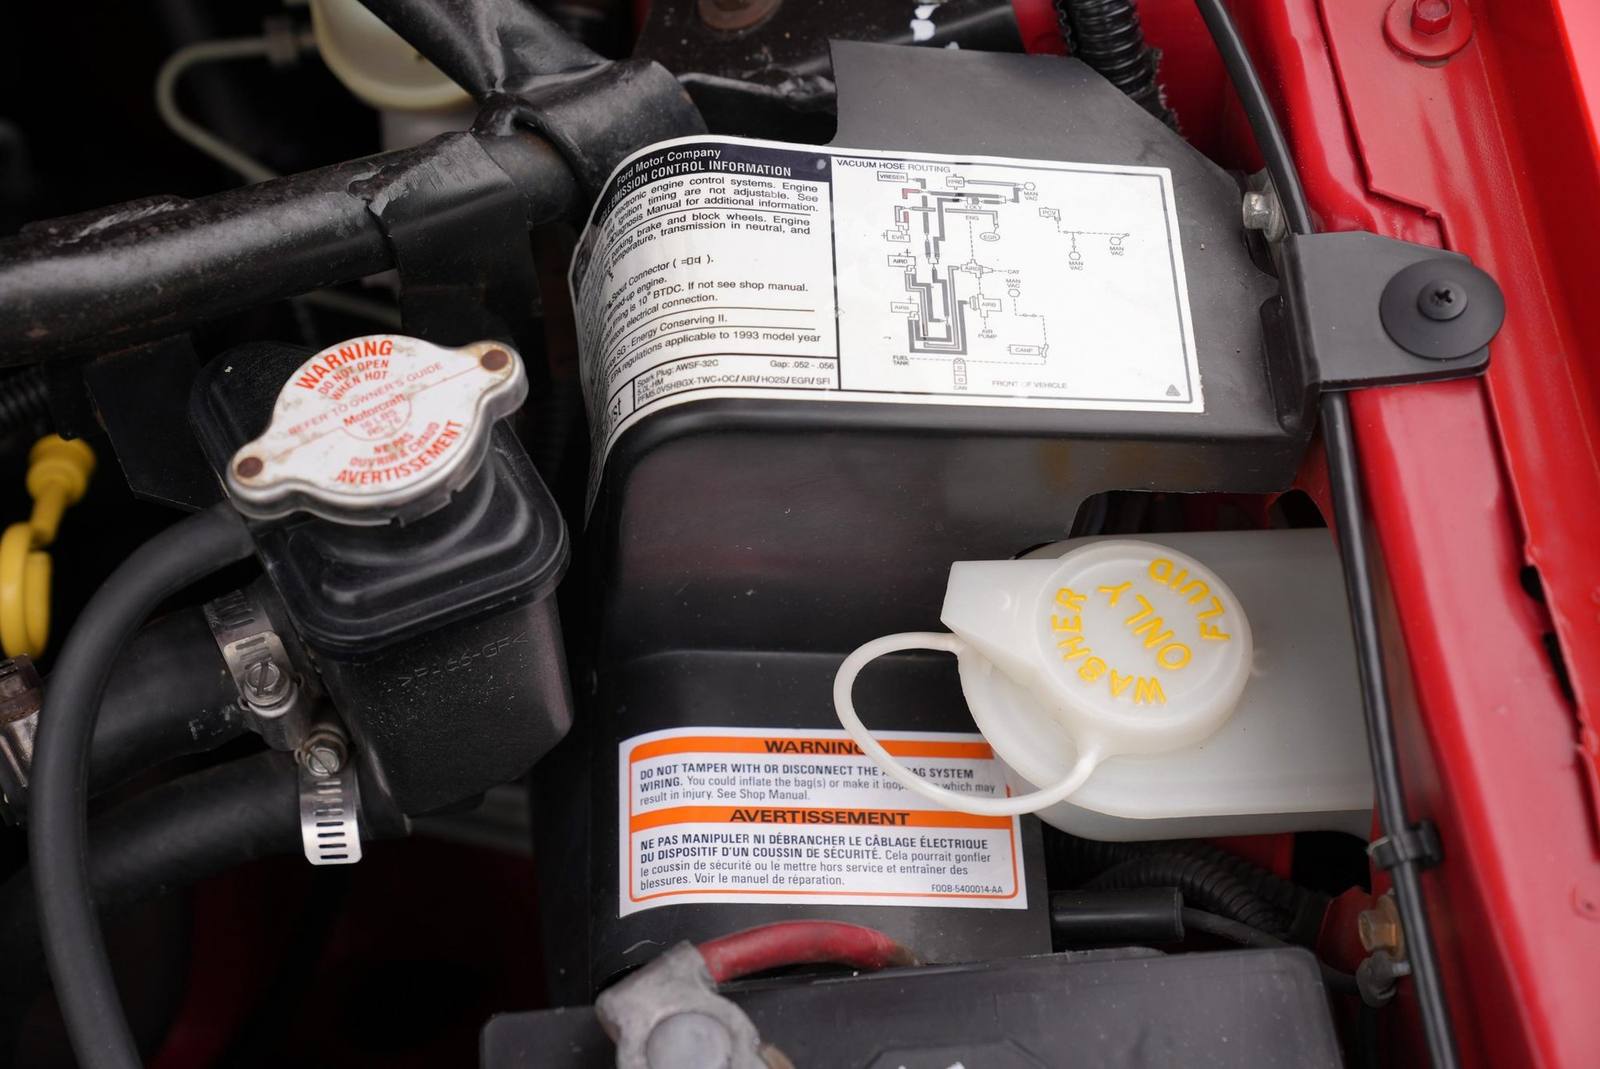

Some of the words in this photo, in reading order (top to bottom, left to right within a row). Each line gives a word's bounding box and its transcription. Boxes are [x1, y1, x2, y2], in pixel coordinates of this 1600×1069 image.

[616, 169, 634, 187] Ford
[636, 156, 664, 172] Motor
[667, 150, 721, 161] Company
[651, 160, 705, 180] CONTROL
[709, 160, 792, 176] INFORMATION
[837, 159, 877, 169] VACUUM
[879, 162, 905, 170] HOSE
[908, 164, 950, 173] ROUTING
[651, 180, 684, 194] engine
[689, 177, 724, 186] control
[730, 178, 776, 189] systems.
[782, 182, 818, 193] Engine
[646, 200, 681, 216] Manual
[686, 198, 698, 206] for
[704, 197, 754, 206] additional
[758, 200, 818, 212] information.
[648, 192, 676, 206] timing
[734, 188, 790, 200] adjustable.
[798, 194, 818, 202] See
[637, 222, 662, 238] brake
[667, 214, 686, 226] and
[692, 212, 720, 220] block
[726, 212, 766, 222] wheels.
[773, 216, 810, 226] Engine
[660, 221, 726, 236] transmission
[732, 220, 740, 230] in
[746, 222, 786, 234] neutral,
[790, 226, 810, 235] and
[628, 262, 670, 286] Connector
[637, 276, 667, 295] engine.
[630, 303, 636, 312] is
[653, 284, 684, 300] BTDC.
[688, 282, 694, 290] If
[698, 280, 714, 289] not
[740, 280, 765, 290] shop
[768, 282, 808, 292] manual.
[626, 304, 659, 328] electrical
[662, 294, 718, 309] connection.
[616, 346, 626, 358] SG
[631, 328, 658, 346] Energy
[660, 314, 715, 332] Conserving
[718, 314, 728, 322] II.
[622, 342, 662, 370] regulations
[665, 332, 716, 348] applicable
[734, 331, 760, 340] 1993
[762, 332, 795, 341] model
[798, 334, 821, 343] year
[294, 340, 393, 390] WARNING
[656, 368, 674, 378] Plug:
[676, 359, 720, 372] AWSF-32C
[770, 360, 790, 368] Gap:
[792, 360, 810, 368] .052
[816, 362, 834, 370] .056
[318, 380, 334, 395] DO
[332, 366, 354, 382] NOT
[357, 360, 389, 372] OPEN
[332, 375, 361, 400] WHEN
[364, 370, 388, 381] HOT
[288, 414, 328, 436] REFER
[332, 403, 348, 416] TO
[406, 362, 442, 382] GUIDE
[336, 419, 464, 485] AVERTISSEMENT
[1148, 558, 1232, 641] FLUID
[1096, 580, 1193, 671] ONLY
[1052, 586, 1167, 704] WASHER
[640, 768, 653, 780] DO
[656, 764, 678, 776] NOT
[682, 762, 728, 773] TAMPER
[730, 764, 760, 774] WITH
[764, 764, 779, 774] OR
[782, 764, 853, 776] DISCONNECT
[858, 766, 878, 776] THE
[930, 768, 974, 778] SYSTEM
[640, 776, 683, 792] WIRING.
[686, 776, 705, 786] You
[708, 776, 736, 786] could
[740, 777, 772, 786] inflate
[775, 778, 791, 786] the
[794, 778, 826, 789] bag(s)
[829, 780, 839, 788] or
[843, 778, 870, 789] make
[872, 779, 880, 789] it
[942, 782, 972, 792] which
[975, 784, 996, 794] may
[640, 790, 667, 806] result
[670, 790, 680, 799] in
[682, 788, 713, 800] injury.
[717, 788, 736, 799] See
[740, 788, 766, 801] Shop
[768, 789, 810, 800] Manual.
[730, 809, 910, 825] AVERTISSEMENT
[640, 839, 654, 851] NE
[658, 836, 678, 847] PAS
[682, 833, 750, 844] MANIPULER
[753, 834, 766, 844] NI
[768, 832, 846, 846] DÉBRANCHER
[849, 836, 862, 846] LE
[865, 834, 917, 848] CÂBLAGE
[920, 836, 988, 850] ÉLECTRIQUE
[640, 852, 654, 864] DU
[658, 846, 718, 860] DISPOSITIF
[722, 846, 749, 856] D'UN
[752, 847, 802, 858] COUSSIN
[806, 848, 820, 858] DE
[823, 848, 882, 860] SÉCURITÉ.
[885, 850, 908, 860] Cela
[911, 851, 952, 863] pourrait
[955, 852, 991, 864] gonfler
[640, 867, 649, 878] le
[652, 861, 690, 875] coussin
[694, 860, 706, 870] de
[710, 860, 752, 870] sécurité
[754, 862, 768, 870] ou
[771, 861, 780, 871] le
[784, 862, 817, 872] mettre
[820, 862, 842, 872] hors
[846, 864, 883, 873] service
[886, 864, 896, 873] et
[900, 864, 946, 874] entraîner
[950, 865, 968, 875] des
[640, 876, 691, 890] blessures.
[694, 873, 714, 884] Voir
[718, 874, 728, 884] le
[732, 874, 769, 884] manuel
[772, 874, 785, 884] de
[788, 874, 845, 886] réparation.
